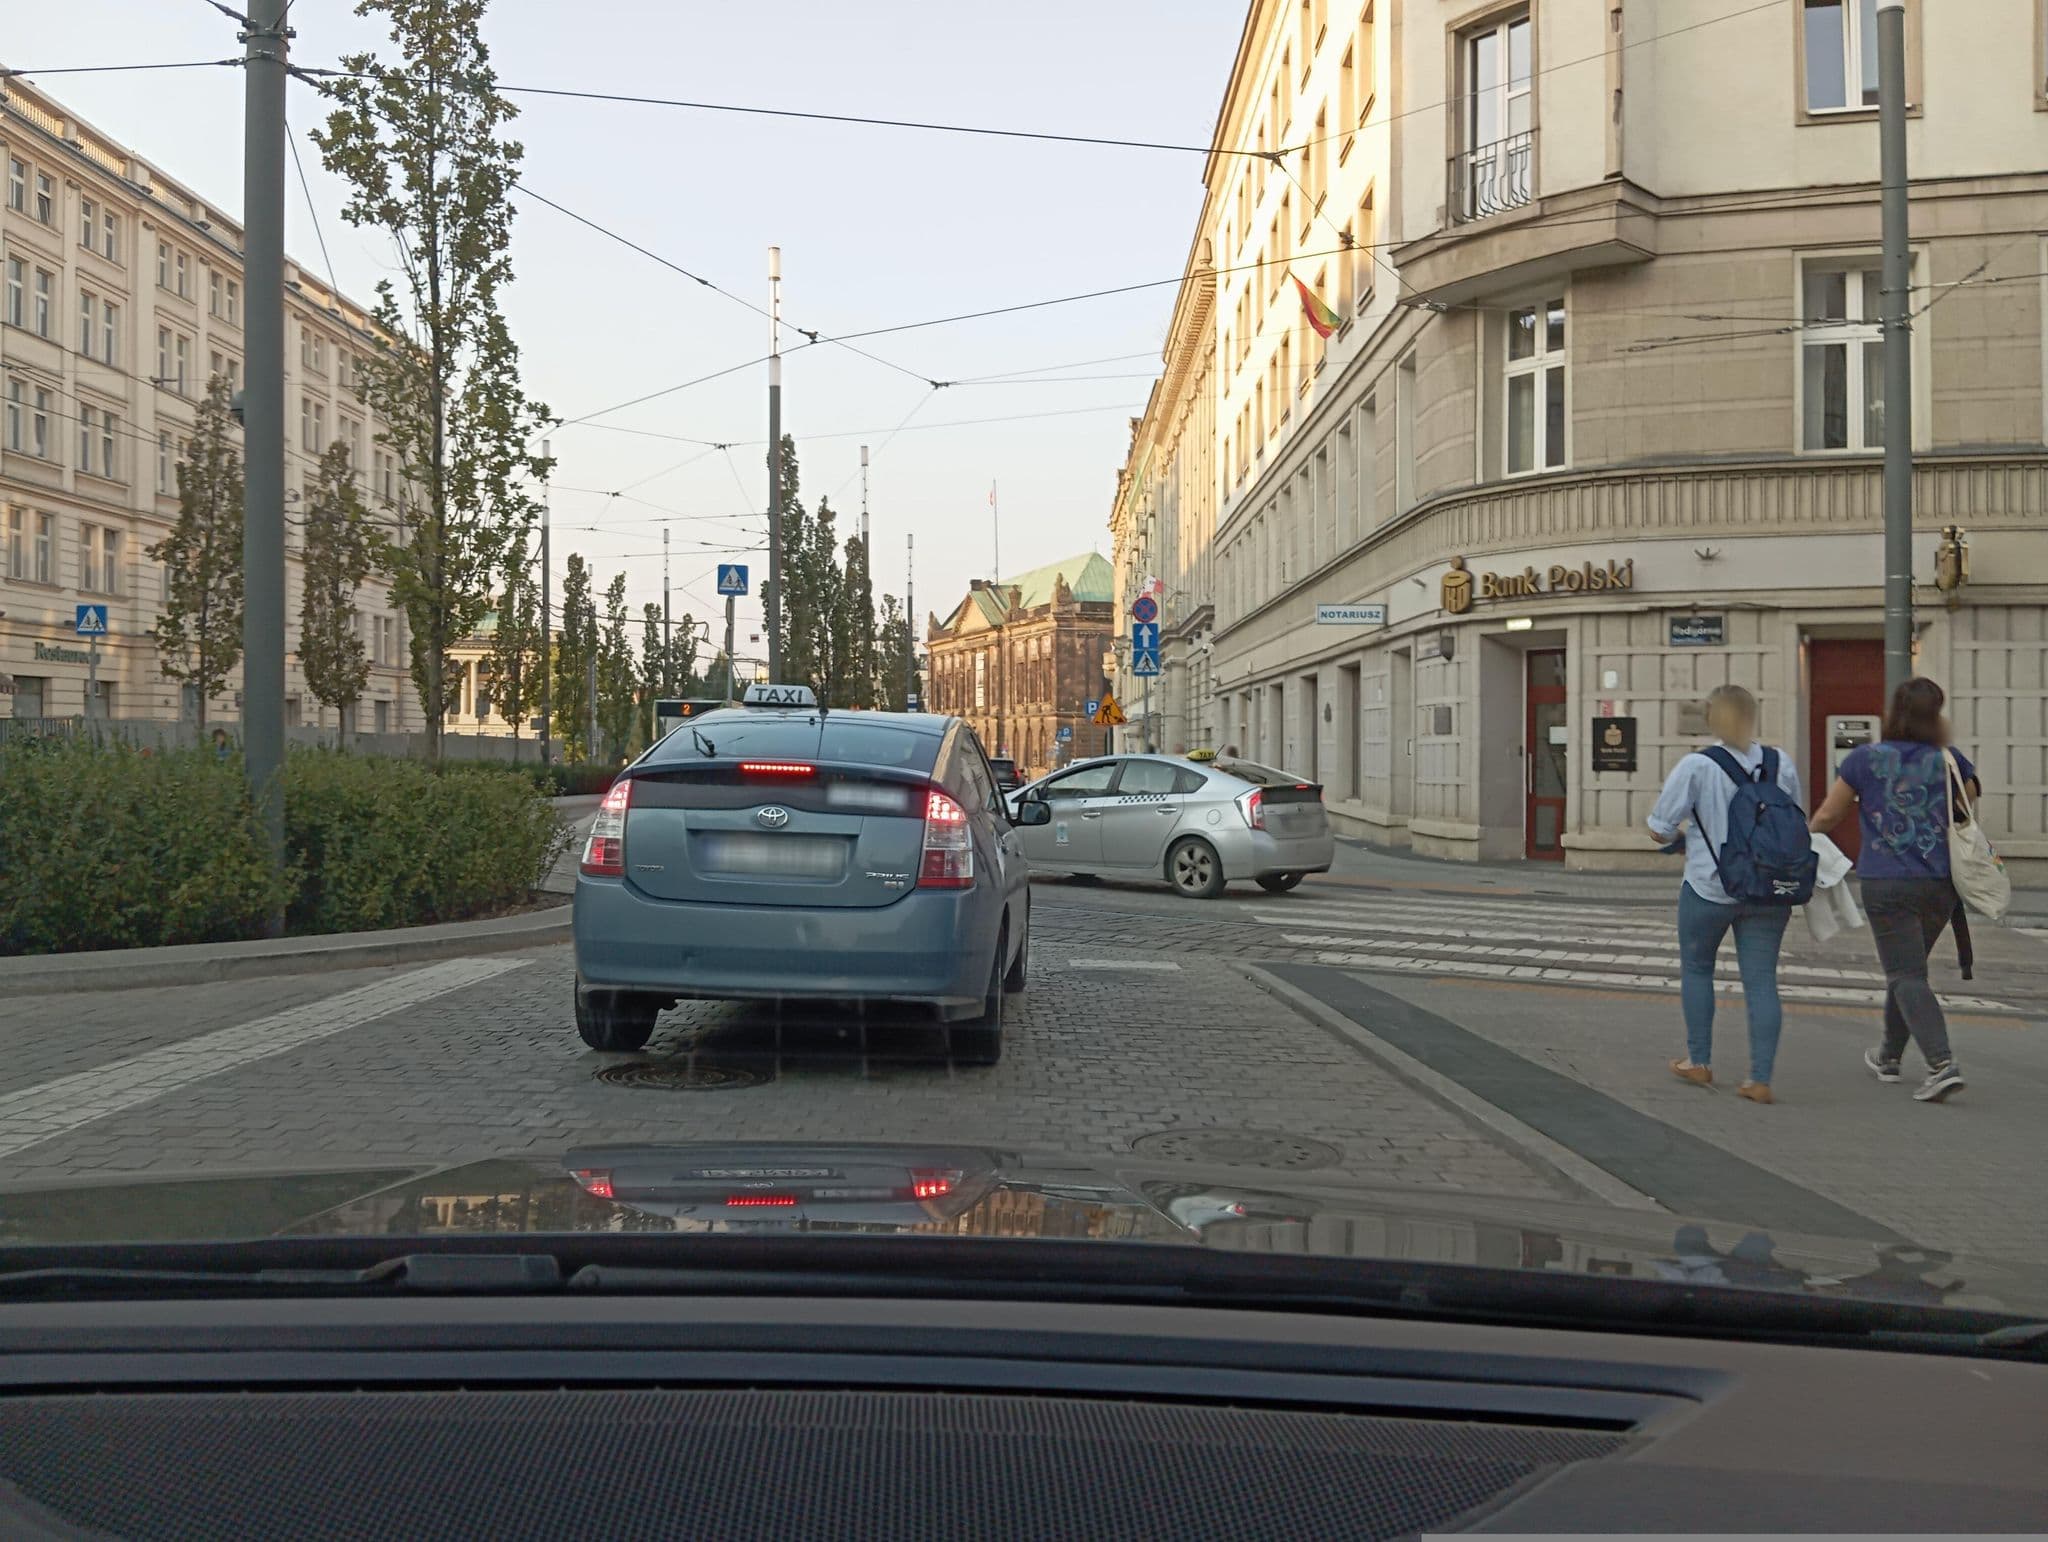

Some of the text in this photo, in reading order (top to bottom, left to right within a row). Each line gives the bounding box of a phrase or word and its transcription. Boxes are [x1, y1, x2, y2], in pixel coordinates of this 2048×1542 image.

[1481, 558, 1634, 598] Bank Polski
[1320, 610, 1381, 619] NOTARIUSZ
[754, 687, 803, 703] TAXI
[682, 703, 691, 716] 2
